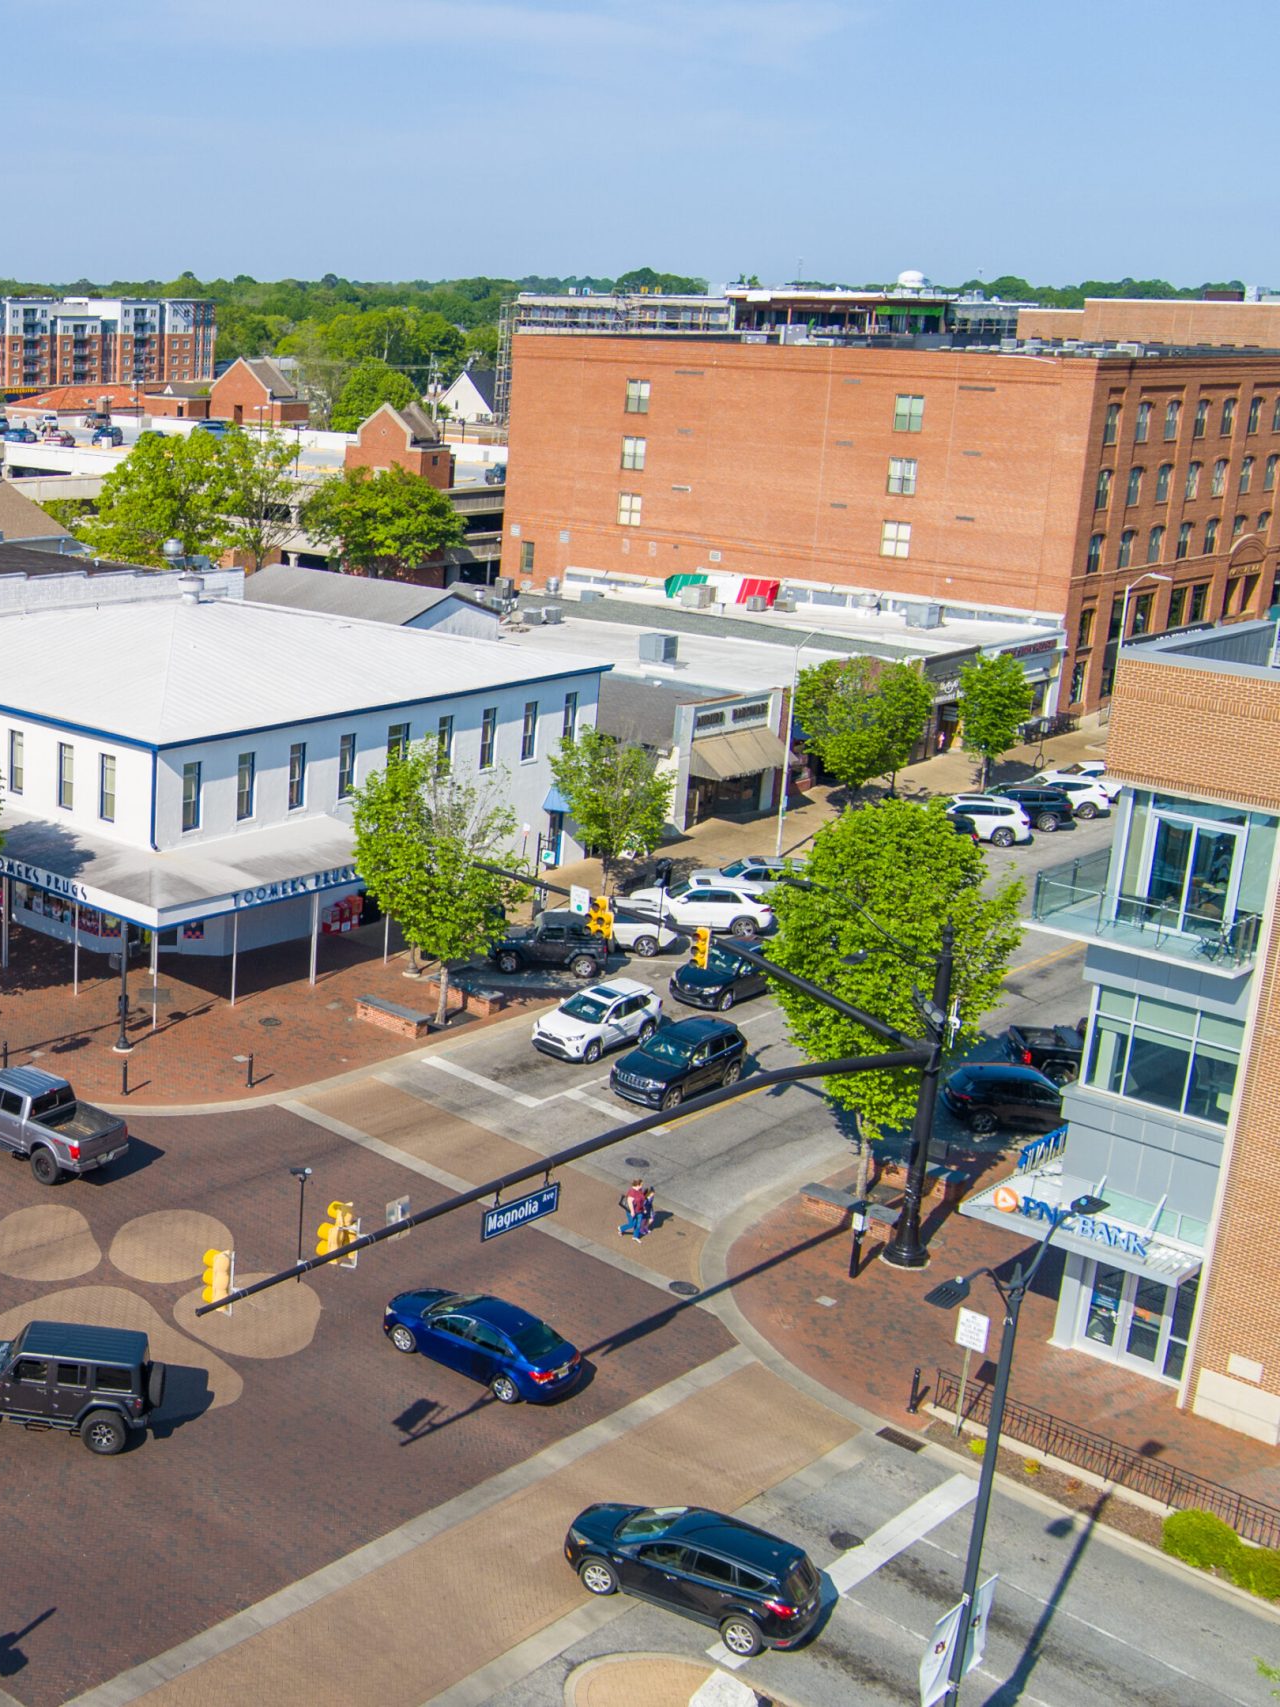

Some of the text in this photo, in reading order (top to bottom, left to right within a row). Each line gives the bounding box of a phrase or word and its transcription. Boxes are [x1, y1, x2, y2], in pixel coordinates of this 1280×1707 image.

[46, 874, 87, 900] DRUGS
[231, 876, 307, 908] TOOMER'S
[488, 1192, 555, 1232] Magnolia Ave
[1022, 1196, 1148, 1257] PNC BANK
